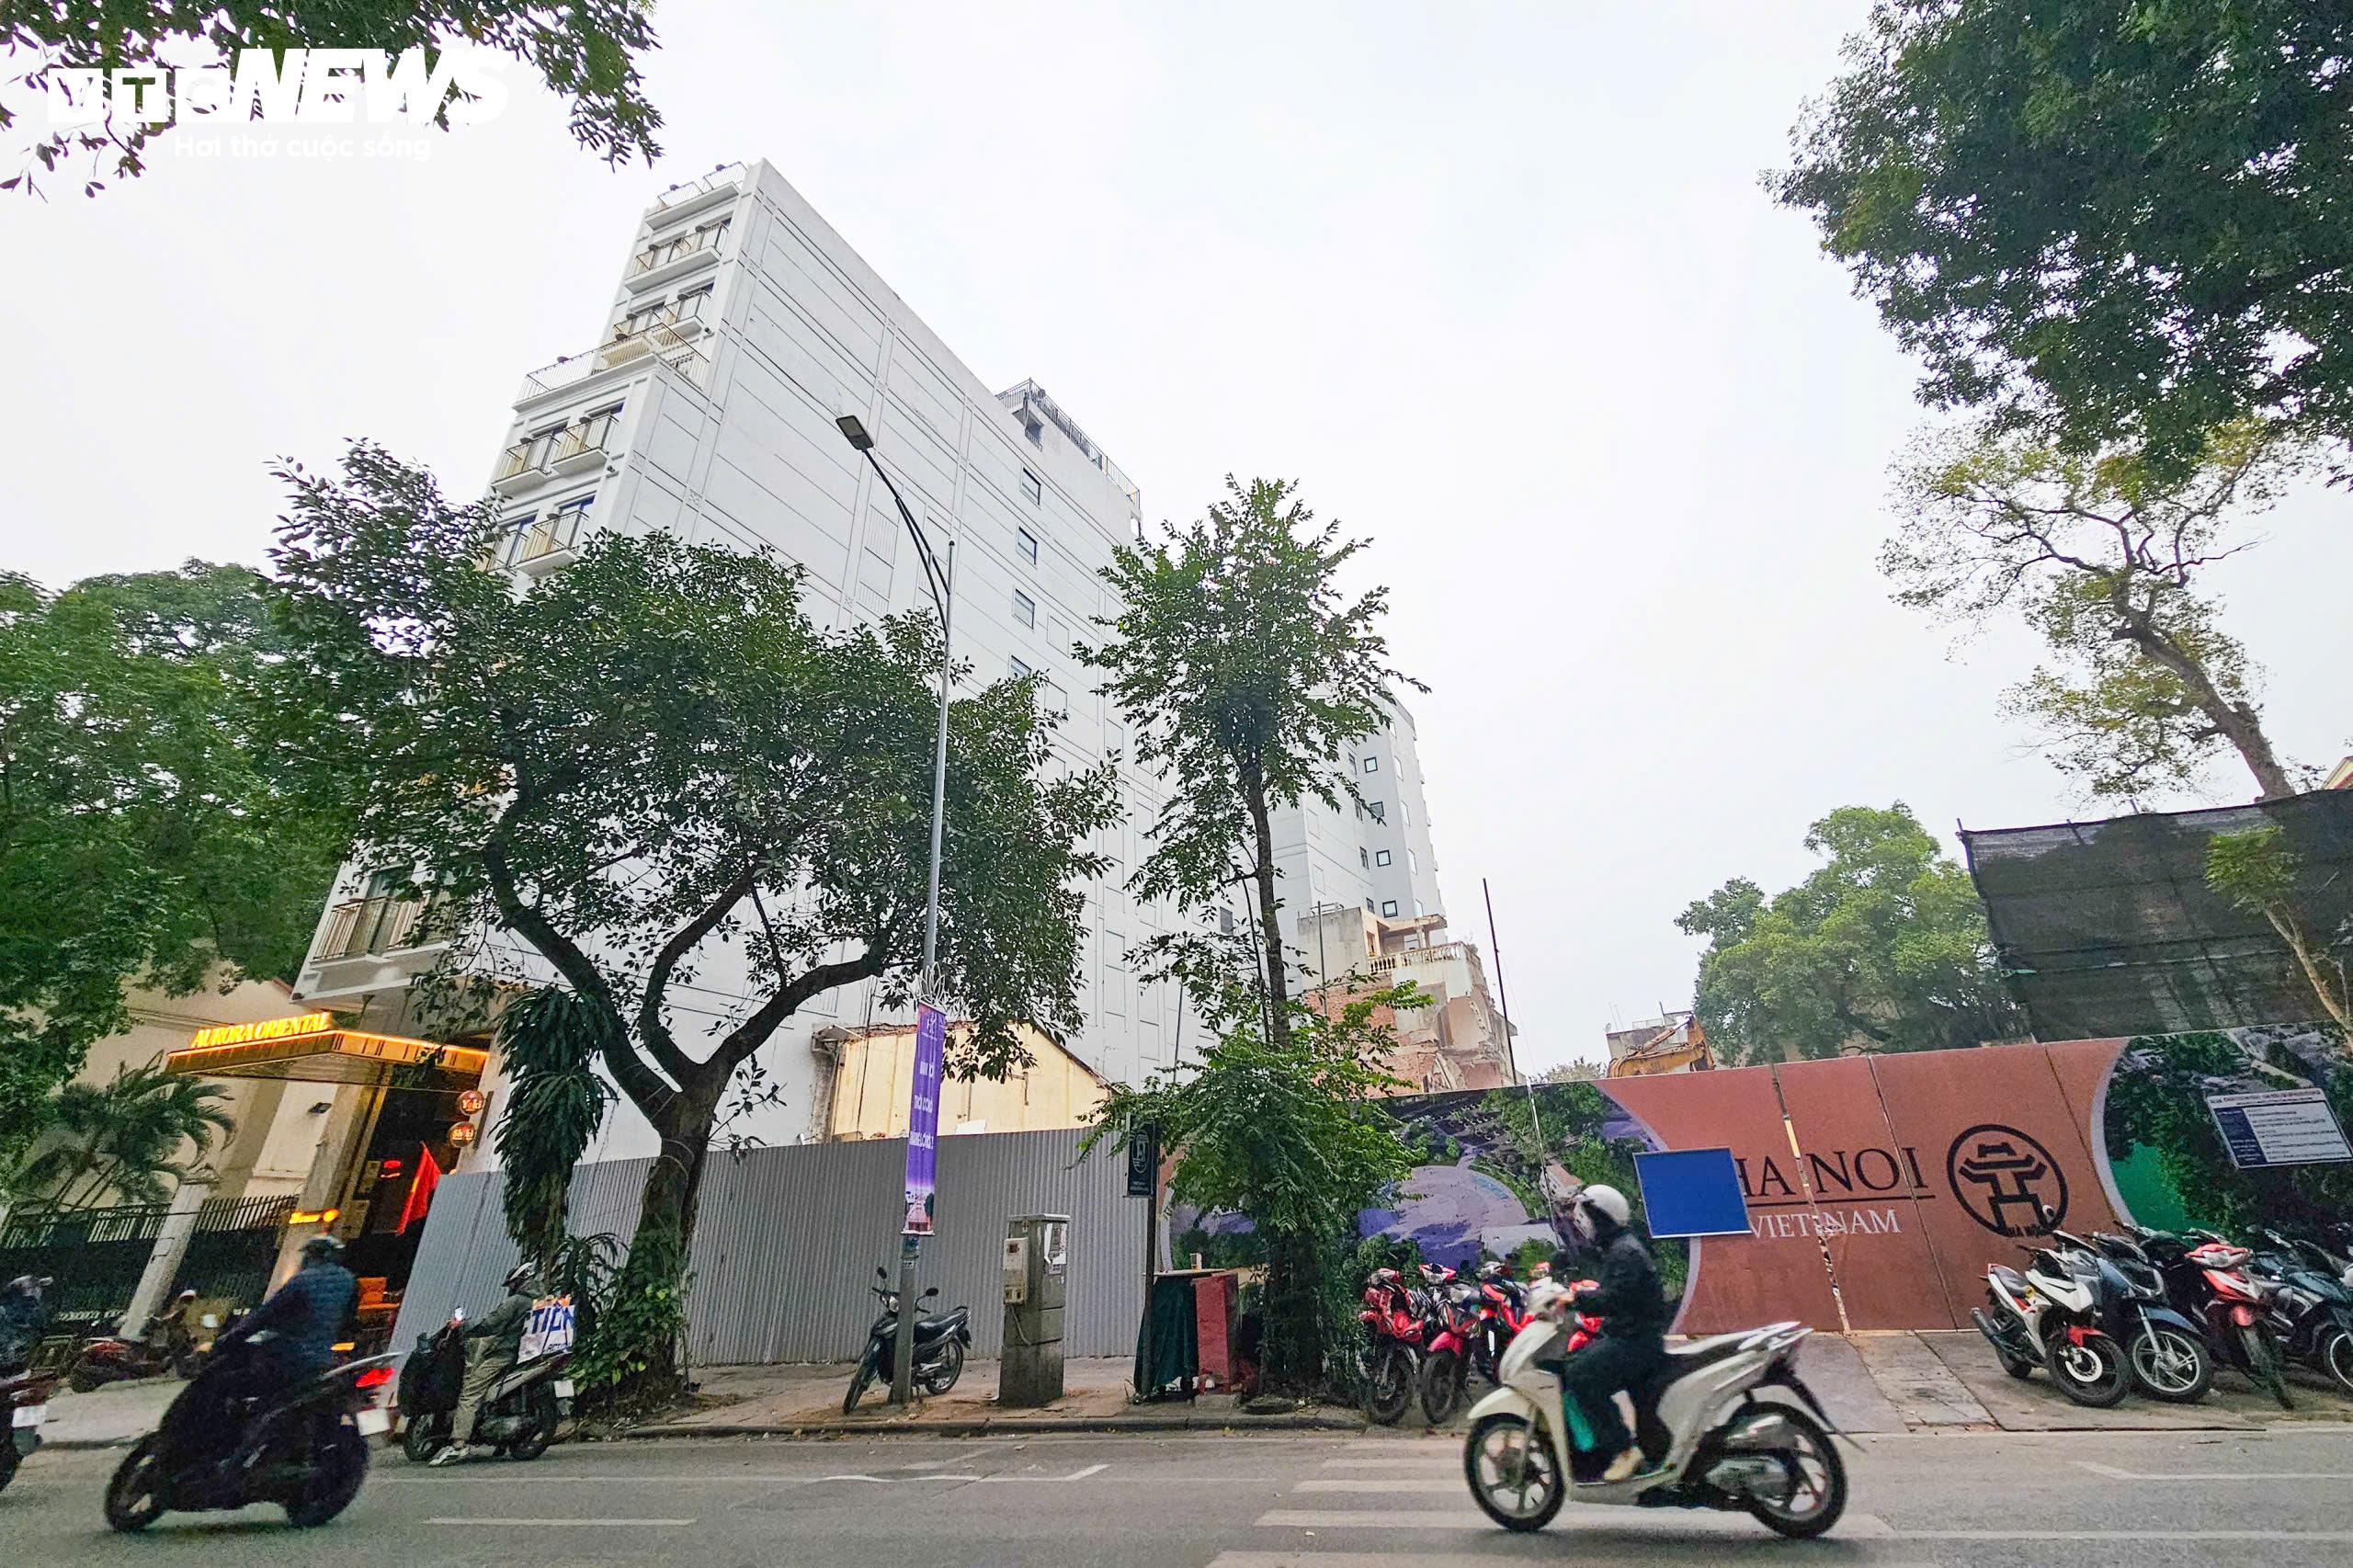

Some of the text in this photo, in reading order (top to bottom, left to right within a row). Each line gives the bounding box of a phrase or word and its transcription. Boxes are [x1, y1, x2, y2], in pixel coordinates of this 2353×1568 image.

[190, 1012, 331, 1049] AURORA ORIENTAL
[1805, 1148, 1928, 1192] NOI
